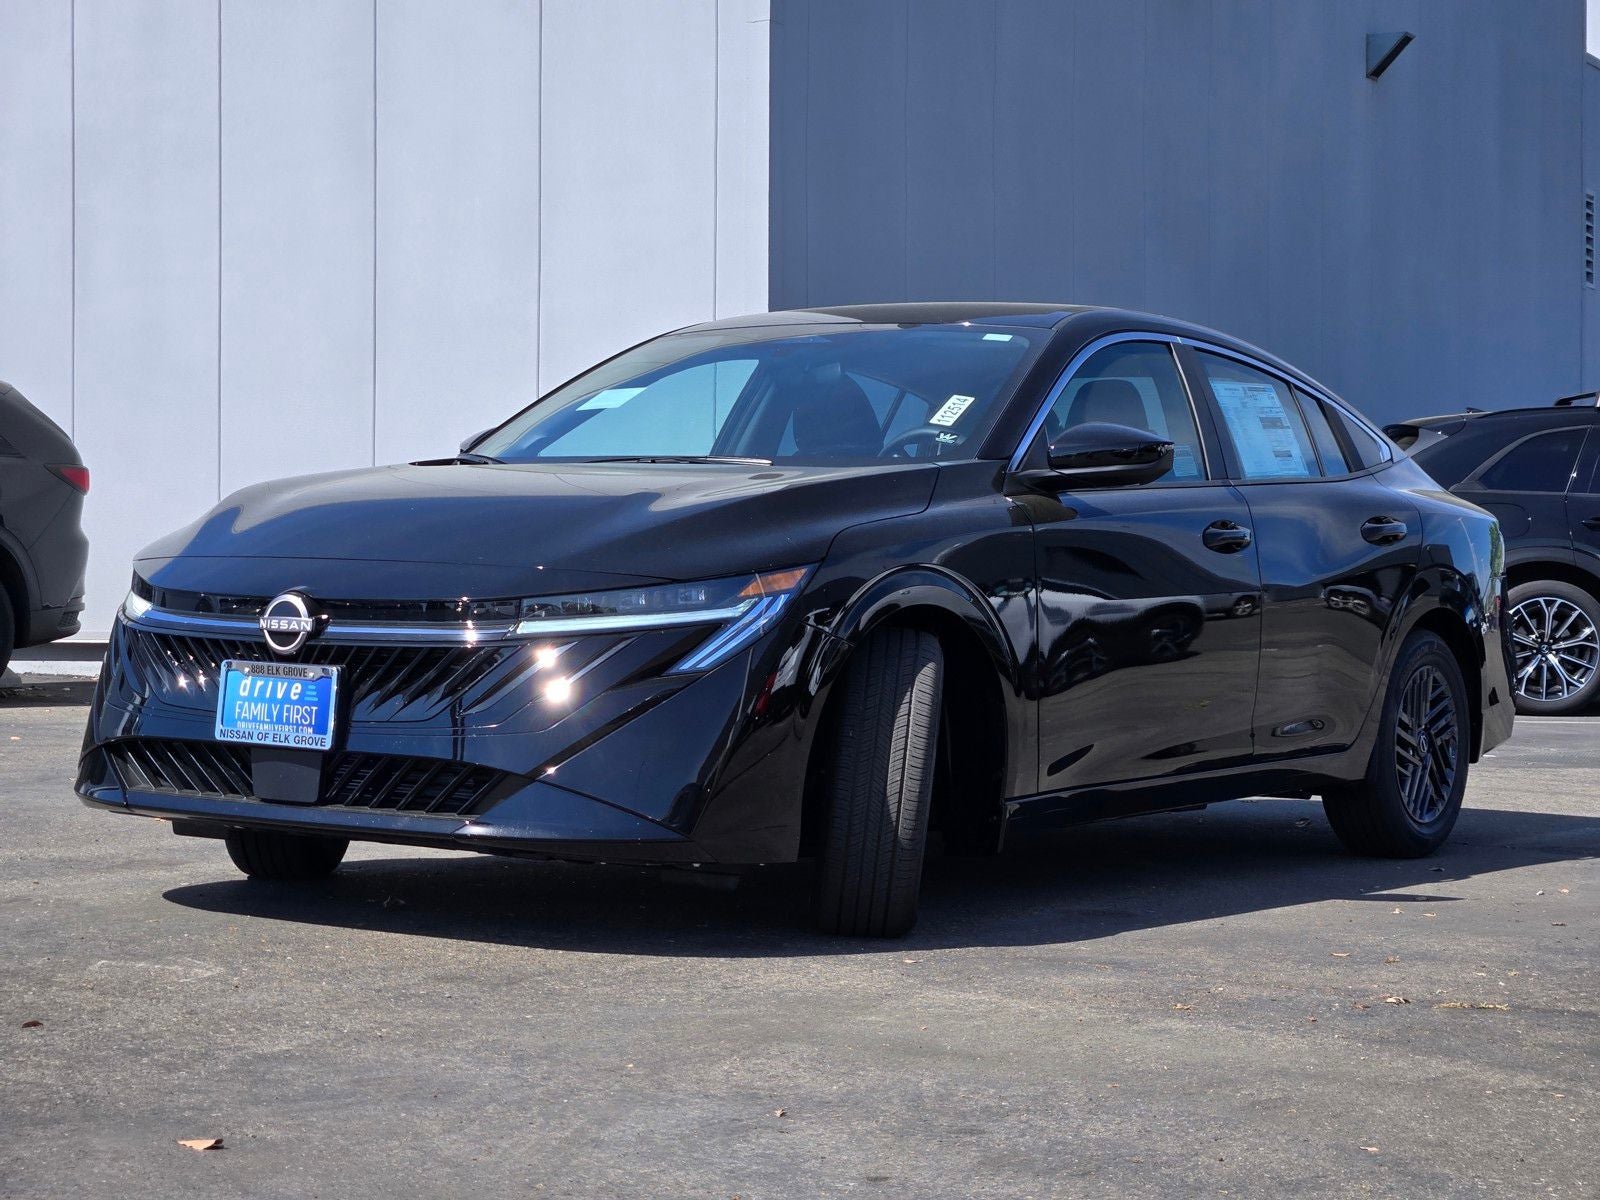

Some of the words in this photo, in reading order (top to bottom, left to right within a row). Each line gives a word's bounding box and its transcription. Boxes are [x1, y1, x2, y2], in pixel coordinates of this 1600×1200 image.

[936, 398, 969, 423] 112514
[260, 619, 311, 630] NISSAN
[267, 666, 280, 675] ELK
[283, 667, 308, 677] GROVE
[239, 676, 302, 700] drive
[235, 701, 280, 722] FAMILY
[283, 704, 318, 725] FIRST
[237, 721, 313, 734] DRIVEFAMILYFIRSTCOM
[219, 728, 254, 741] NISSAN
[256, 731, 269, 742] OF
[272, 732, 291, 744] ELK
[293, 735, 326, 747] GROVE
